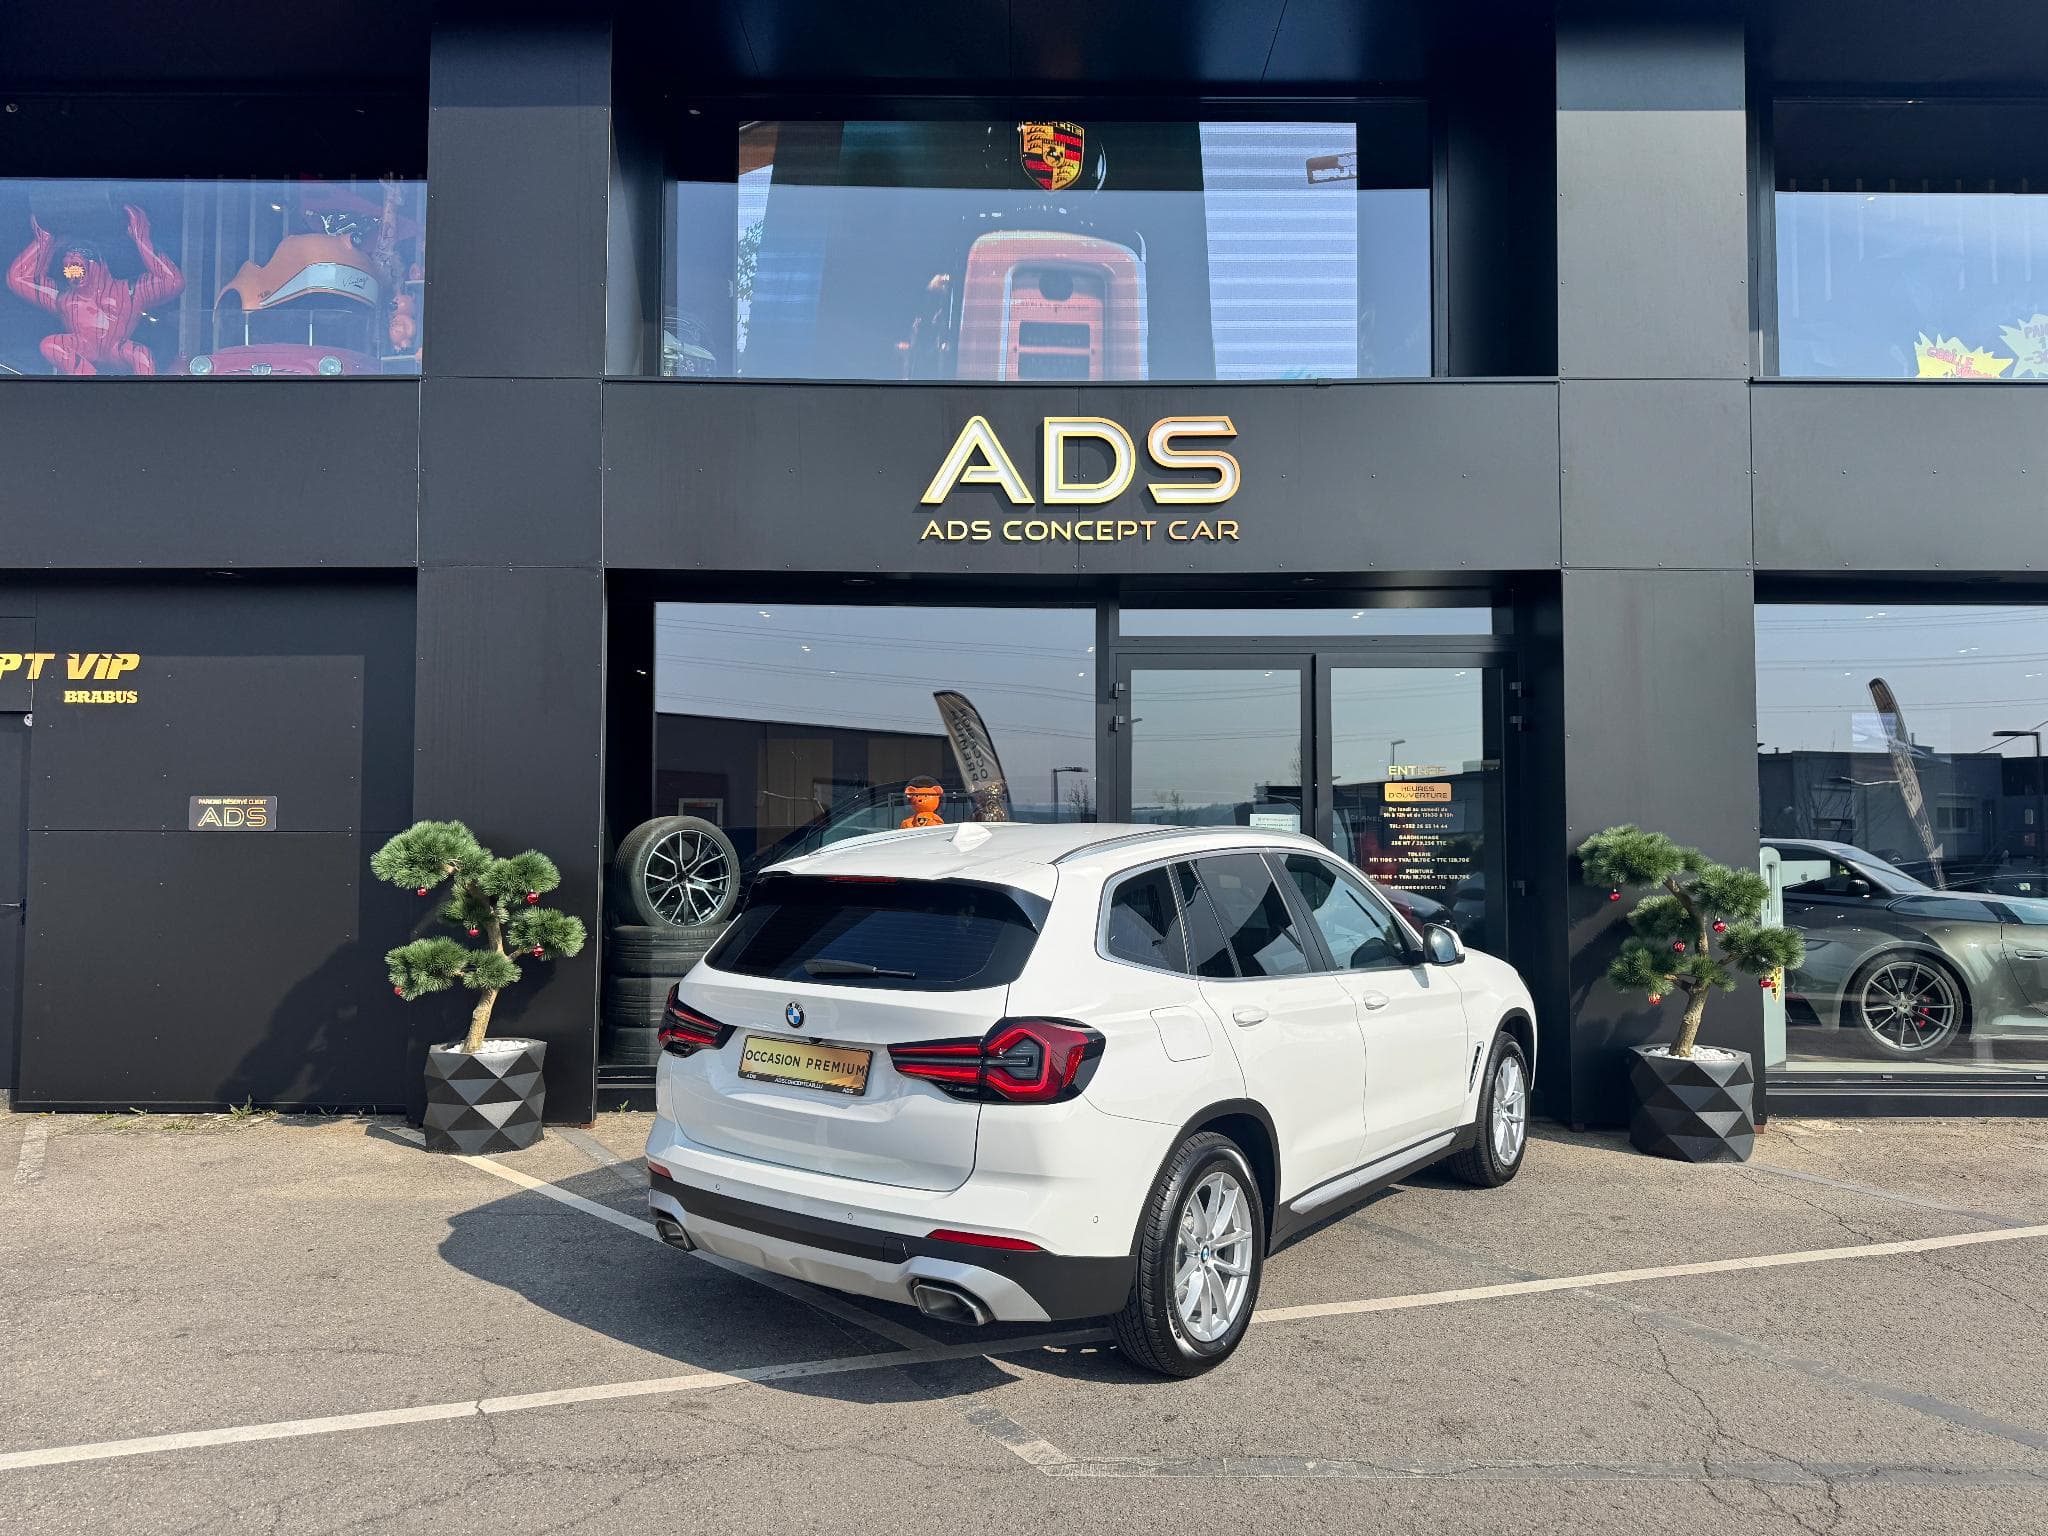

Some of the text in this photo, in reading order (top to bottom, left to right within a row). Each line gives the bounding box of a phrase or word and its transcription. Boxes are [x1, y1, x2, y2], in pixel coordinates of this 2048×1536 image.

[920, 415, 1241, 504] ADS
[920, 519, 1240, 541] ADS CONCEPT CAR
[63, 690, 138, 704] BRABUS
[197, 806, 267, 827] ADS
[745, 1049, 866, 1077] OCCASION PREMIUM
